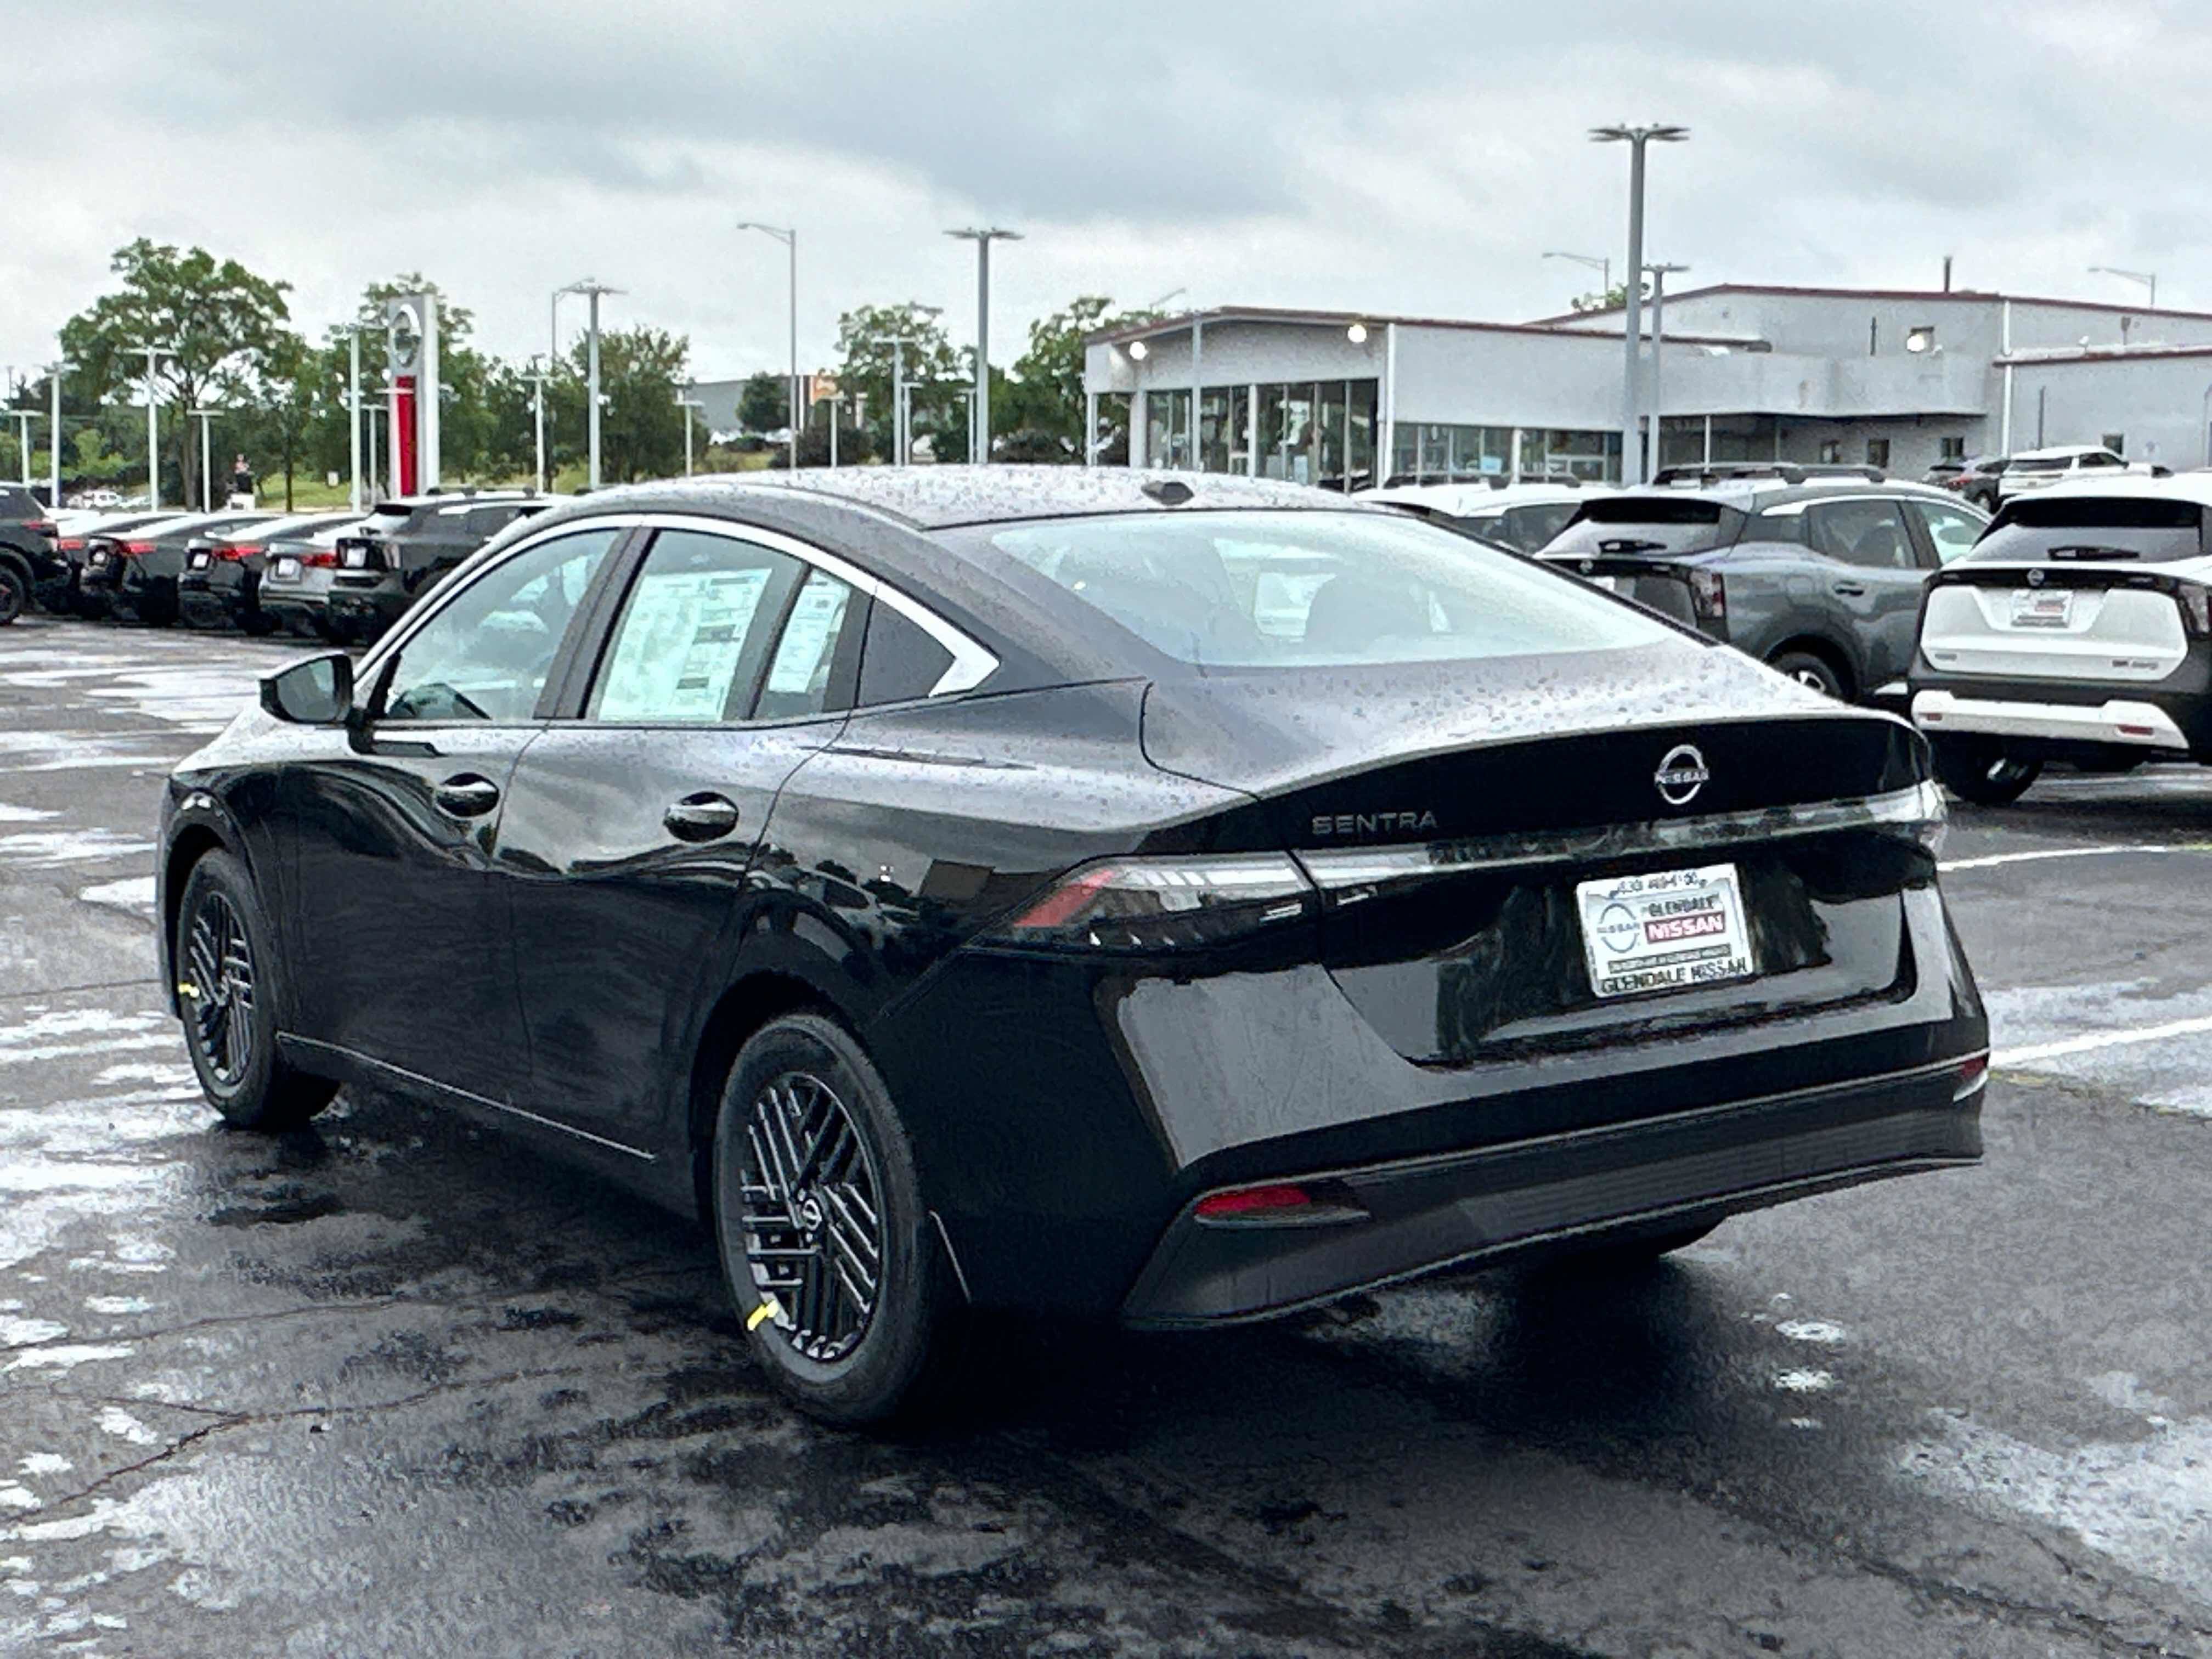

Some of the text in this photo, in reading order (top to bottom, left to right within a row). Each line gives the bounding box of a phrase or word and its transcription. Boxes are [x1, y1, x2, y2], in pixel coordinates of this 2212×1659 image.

[1312, 811, 1438, 835] SENTRA
[1647, 914, 1724, 941] NISSAN
[1601, 967, 1686, 994] GLENDALE
[1690, 956, 1748, 980] NISSAN
